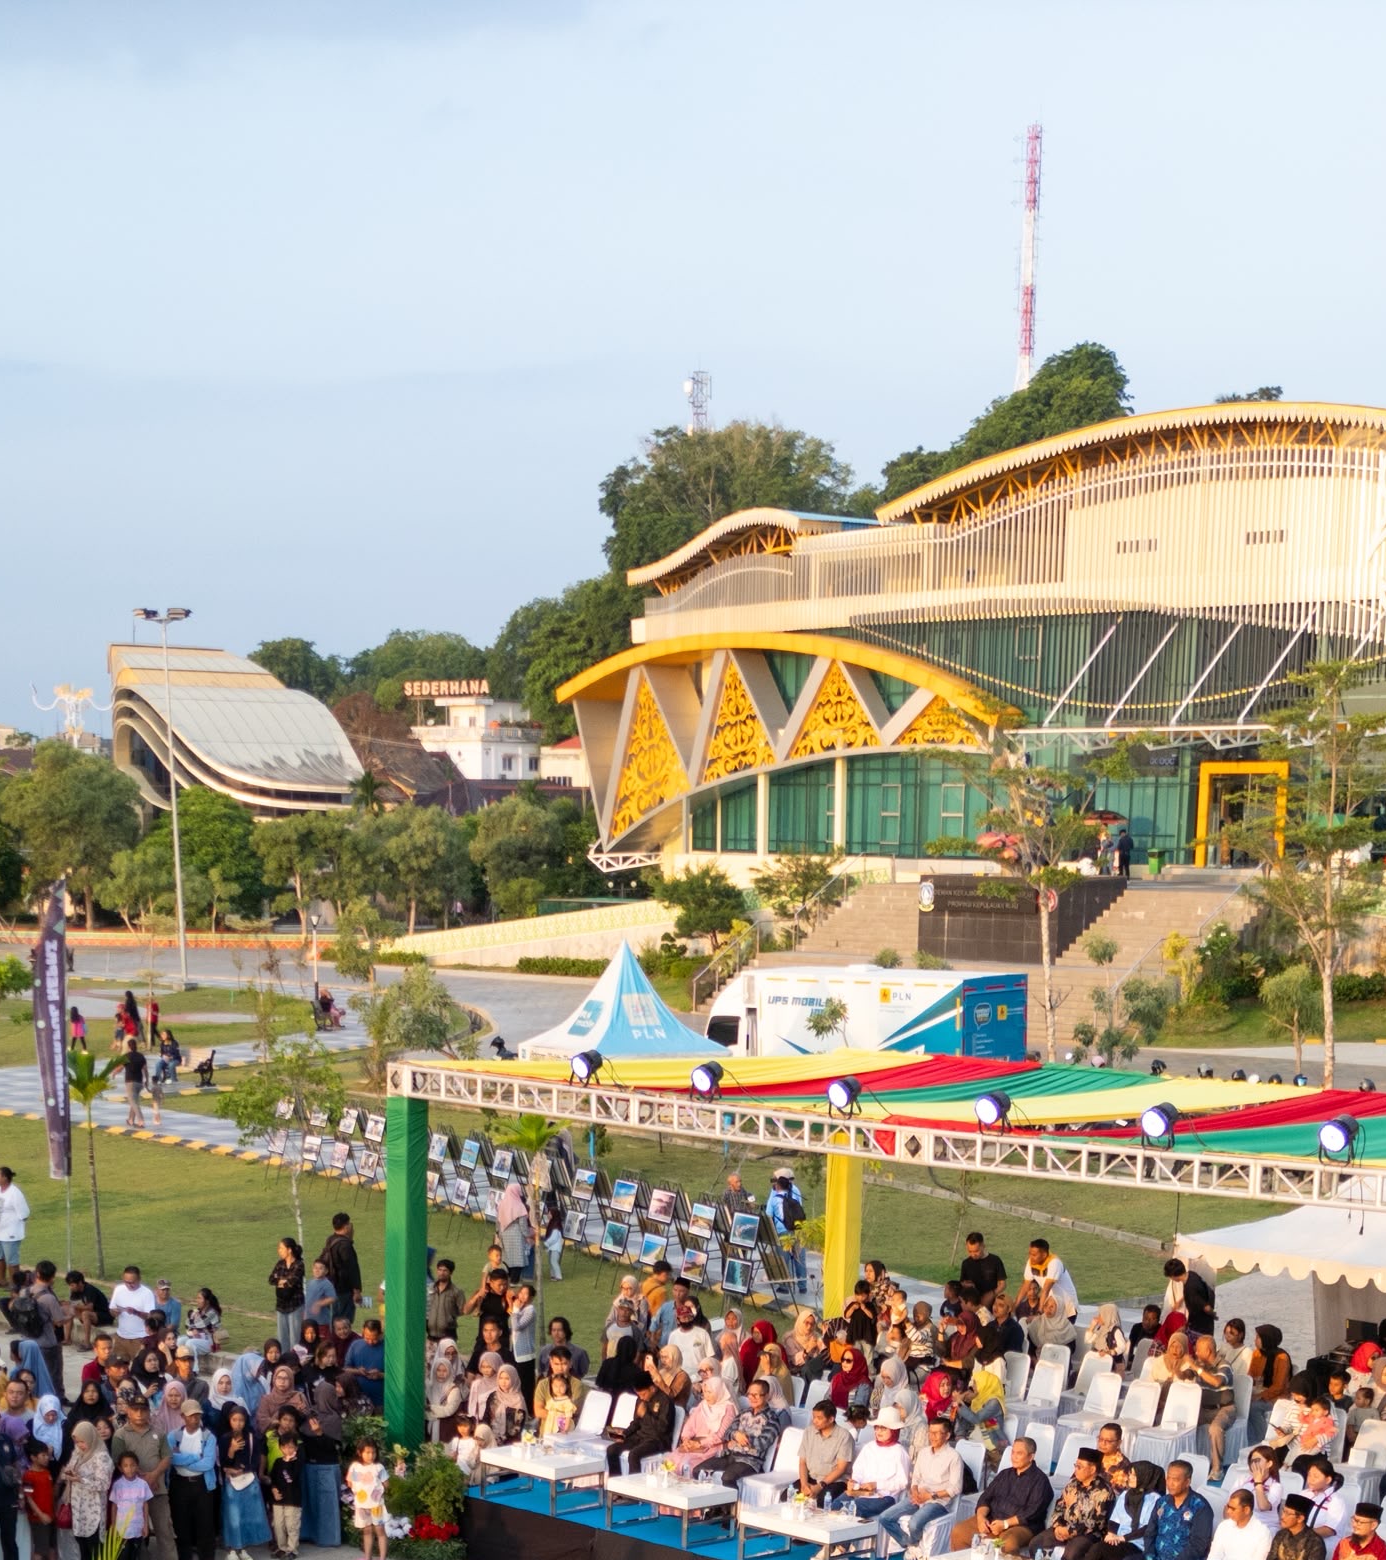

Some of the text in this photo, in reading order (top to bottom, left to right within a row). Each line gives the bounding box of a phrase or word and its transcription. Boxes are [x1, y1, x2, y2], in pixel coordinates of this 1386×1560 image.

[404, 679, 490, 697] SEDERHANA
[768, 995, 788, 1004] UPS
[892, 992, 911, 1001] PLN
[632, 1029, 667, 1039] PLN
